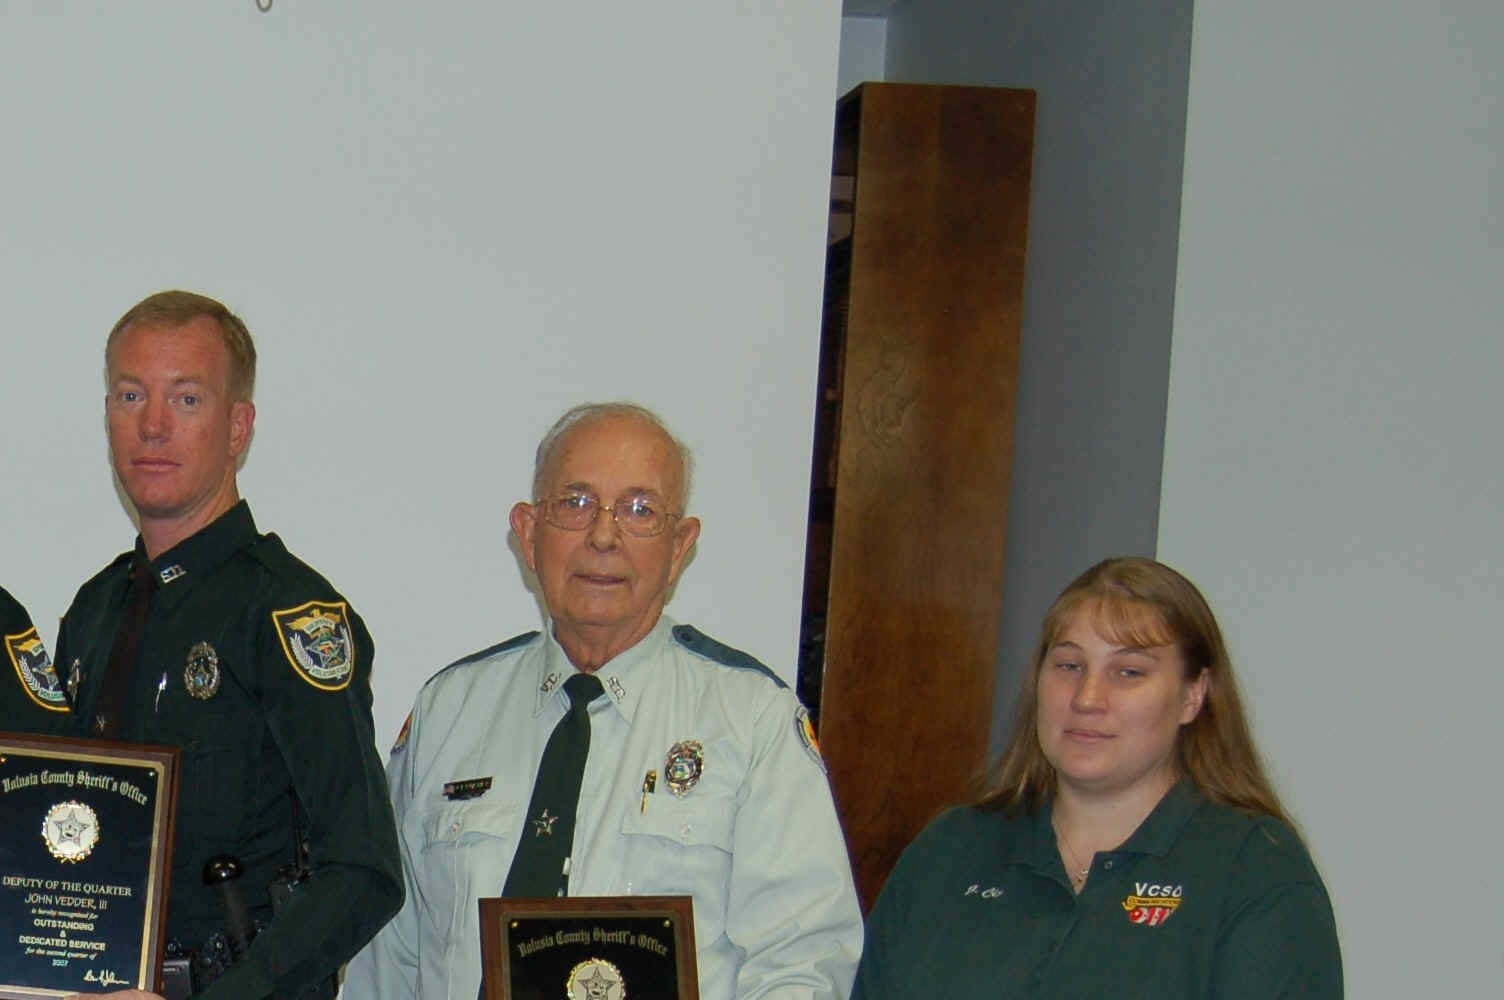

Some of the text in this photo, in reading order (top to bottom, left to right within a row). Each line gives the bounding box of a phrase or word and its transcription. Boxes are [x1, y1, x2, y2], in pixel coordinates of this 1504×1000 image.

[2, 770, 149, 806] Volusia County Sheriff's Office
[2, 876, 132, 896] DEPUTY OF THE QUARTER
[1135, 882, 1183, 897] VCSO
[25, 892, 108, 909] JOHN VEDDER, III
[34, 918, 94, 931] OUTSTANDING
[18, 936, 106, 951] DEDICATED SERVICE
[517, 927, 668, 958] Volusia County Sheriff's Office
